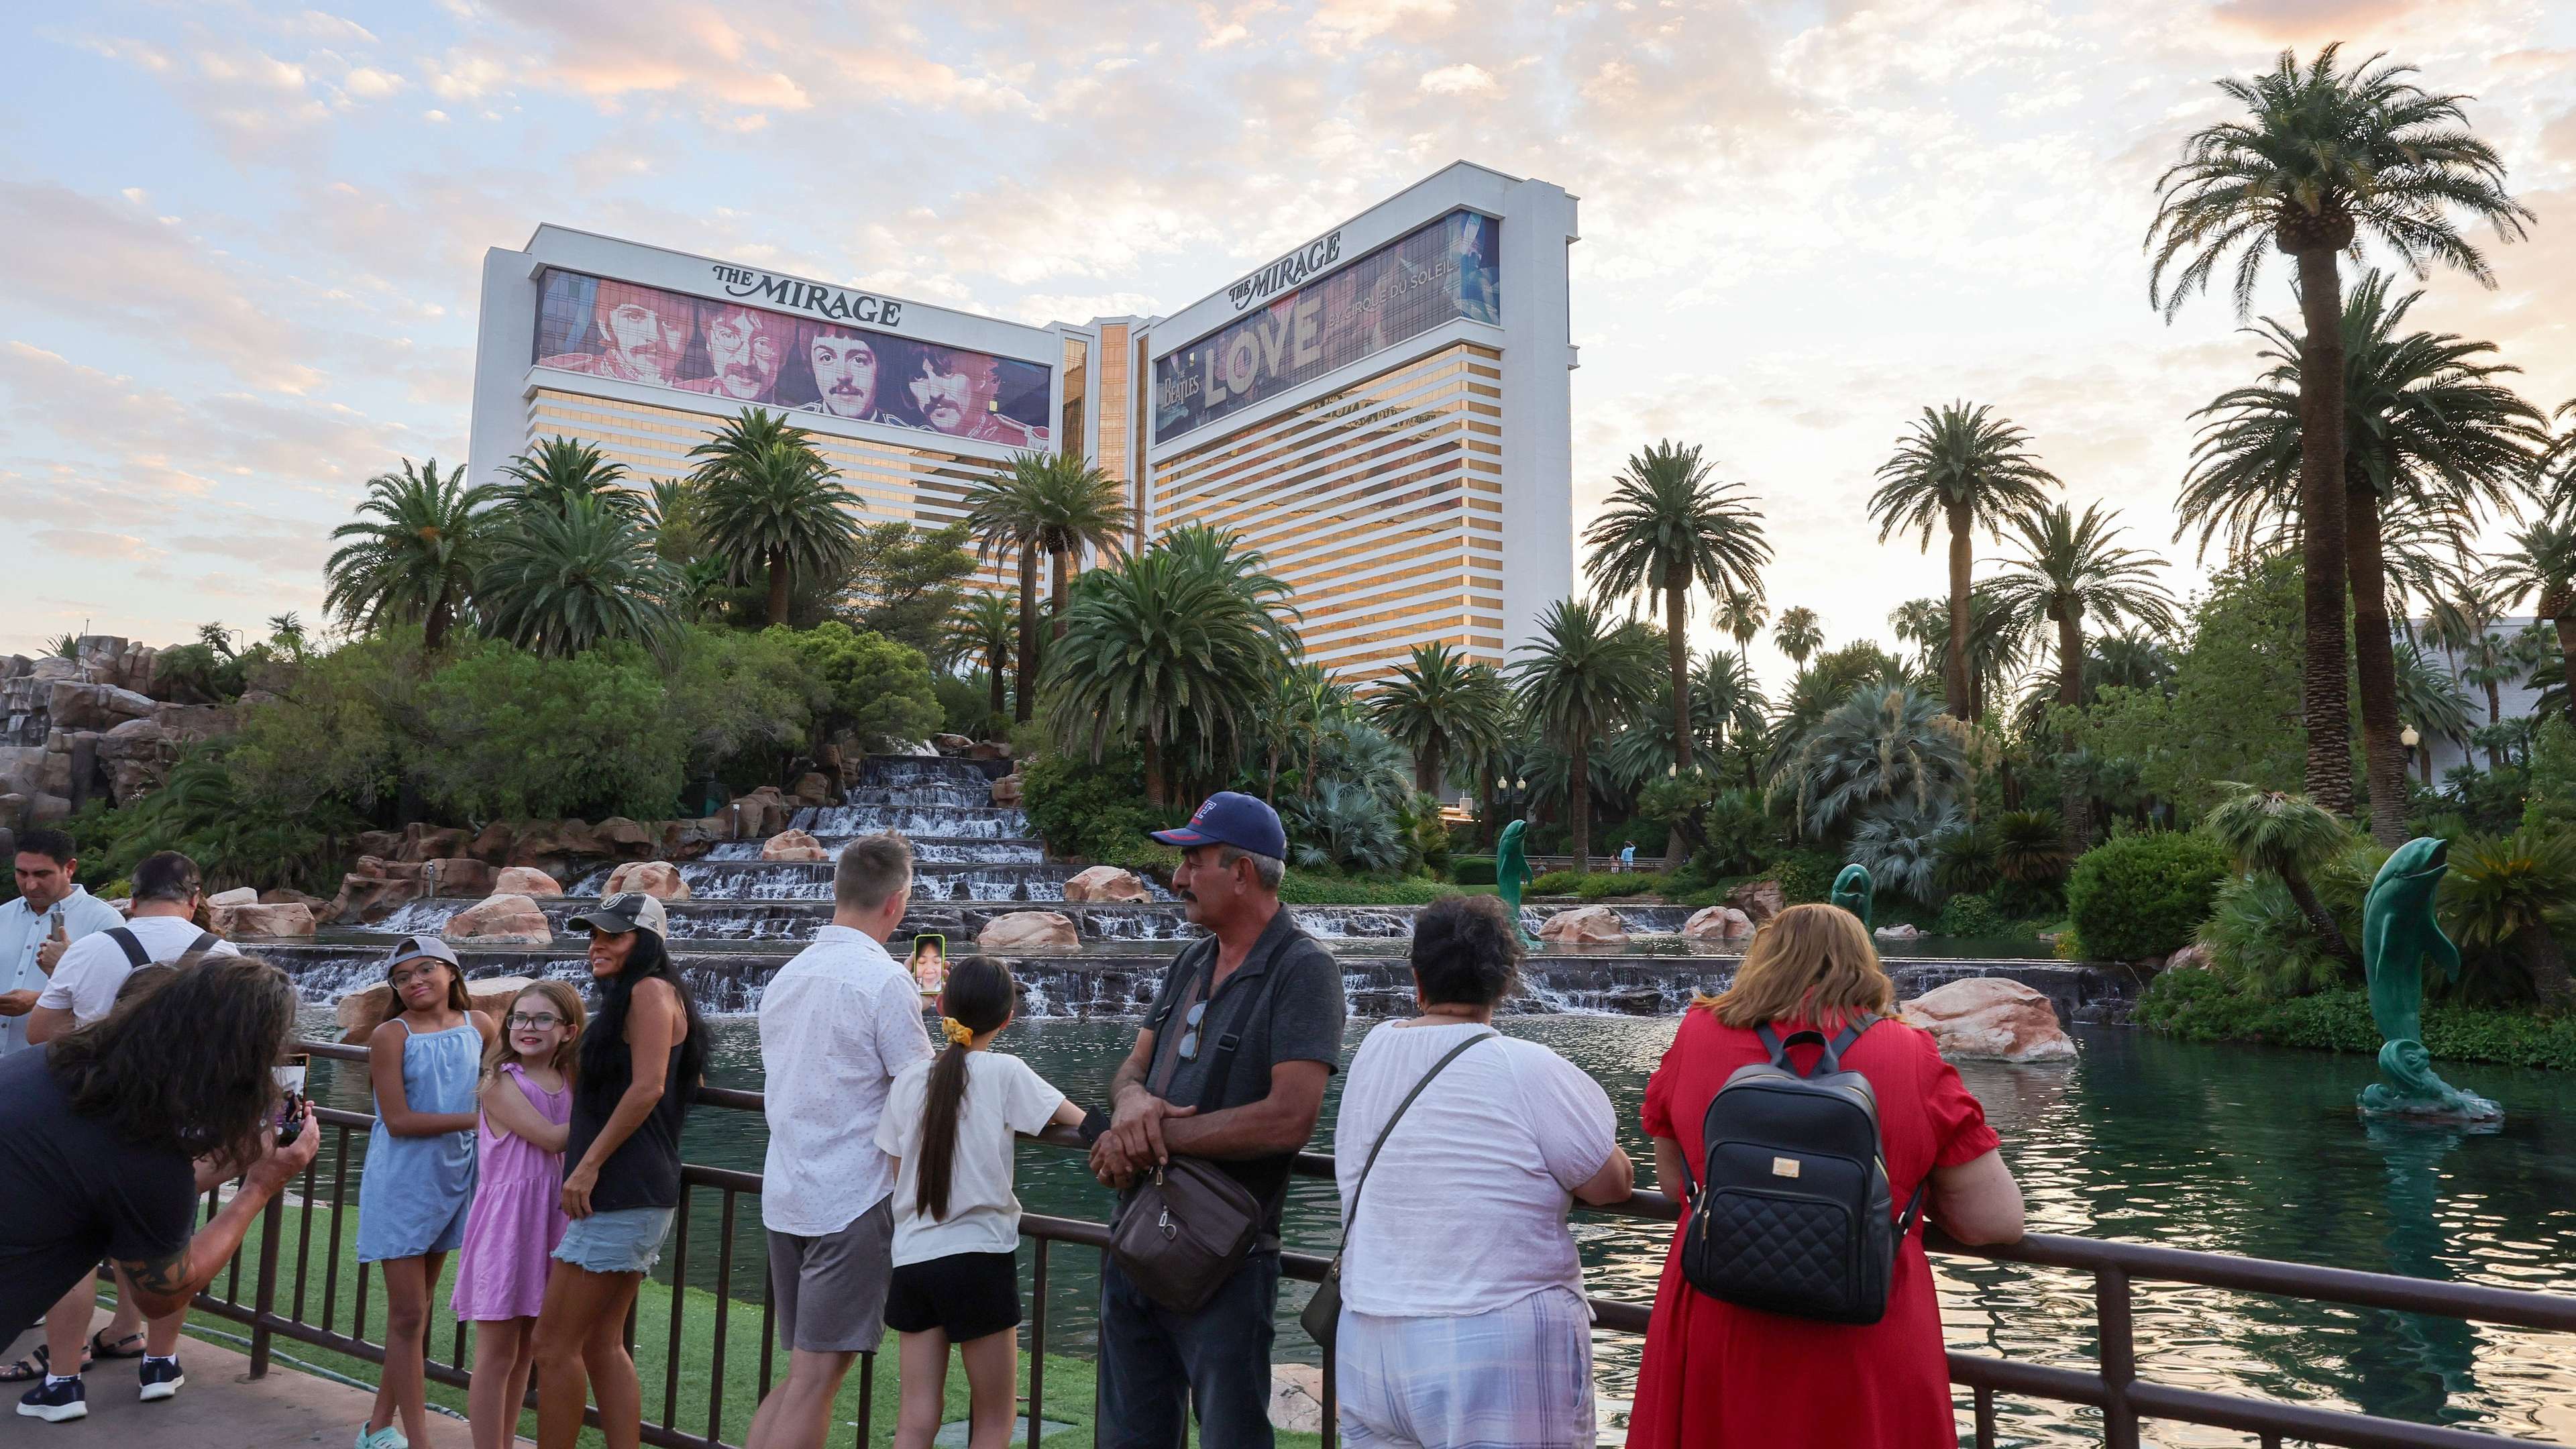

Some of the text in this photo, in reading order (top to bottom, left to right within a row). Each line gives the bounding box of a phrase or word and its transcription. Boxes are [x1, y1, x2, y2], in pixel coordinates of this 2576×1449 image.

[712, 265, 902, 327] THE MIRAGE
[1229, 231, 1341, 311] THE MIRAGE
[1329, 259, 1454, 327] BY CIRQUE DU SOLEIL
[1177, 370, 1185, 379] THE
[1205, 295, 1322, 409] LOVE
[1163, 374, 1199, 409] BEATLES
